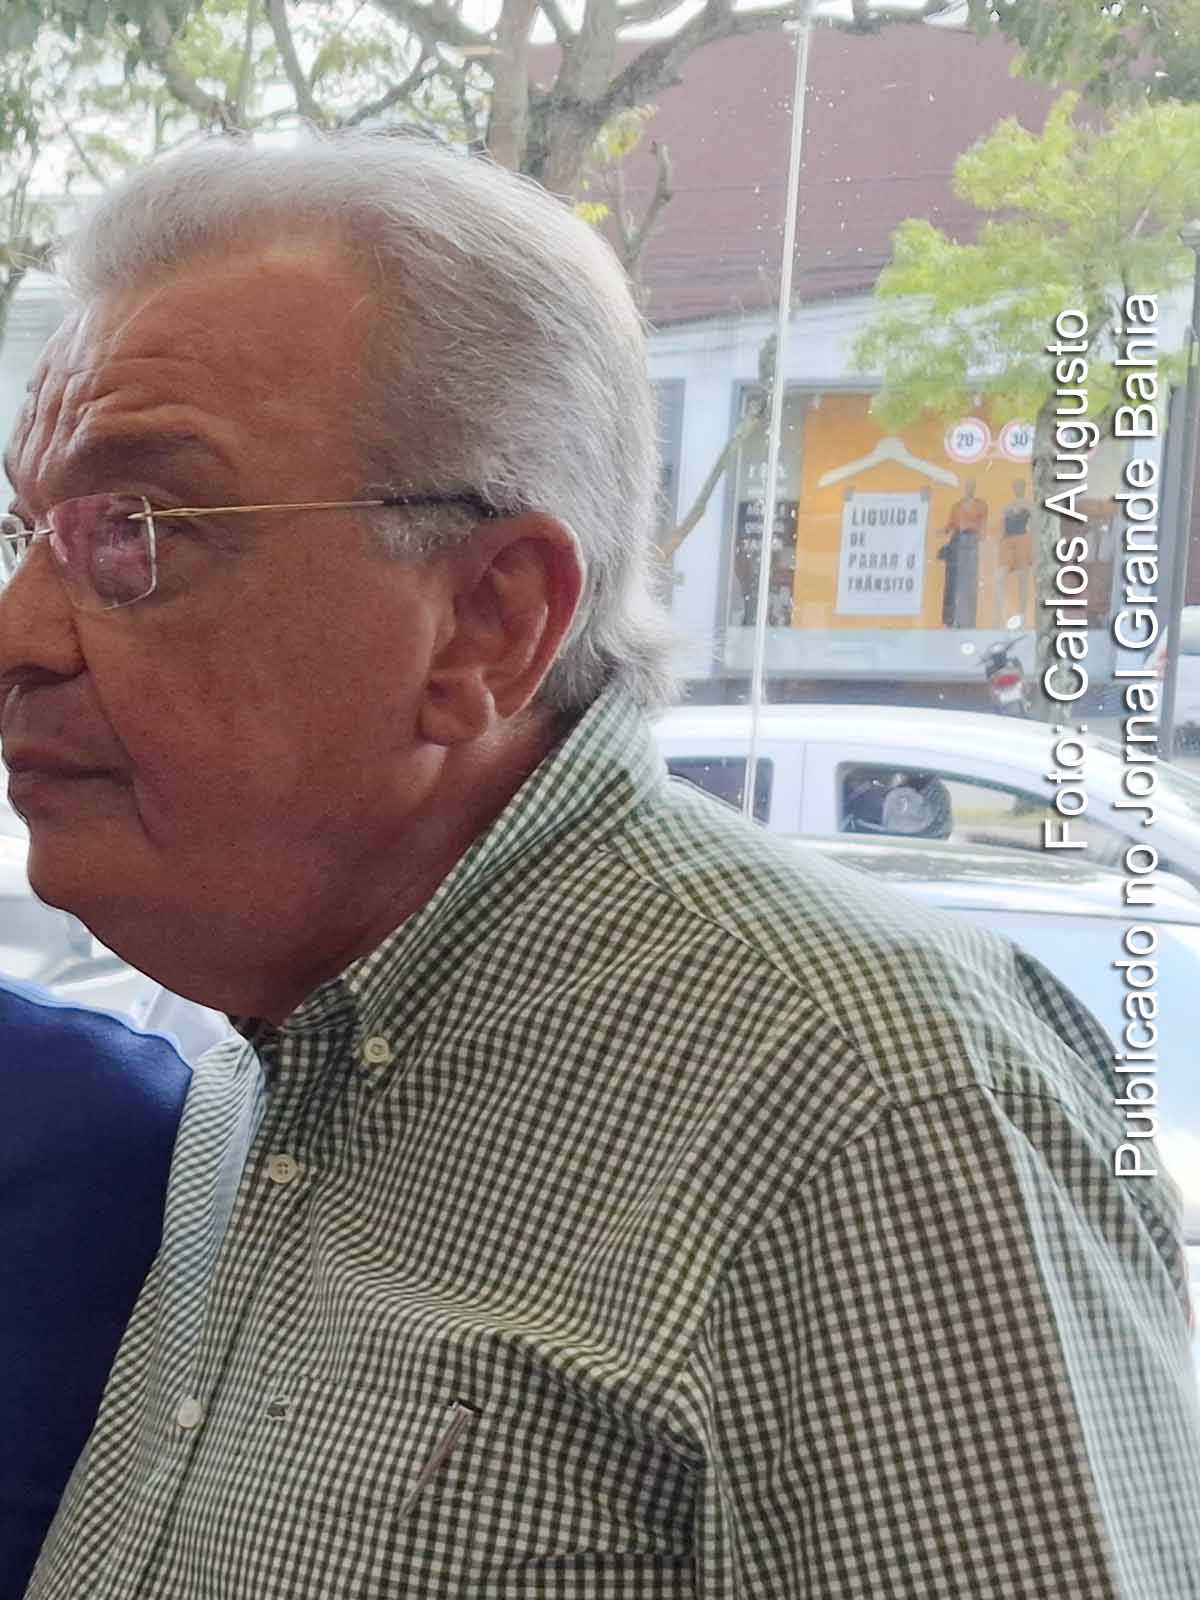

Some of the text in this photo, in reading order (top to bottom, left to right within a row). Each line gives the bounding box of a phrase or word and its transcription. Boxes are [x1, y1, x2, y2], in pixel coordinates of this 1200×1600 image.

[850, 506, 919, 527] LIQUIDA
[849, 531, 866, 547] DE
[847, 553, 916, 570] PARAR O
